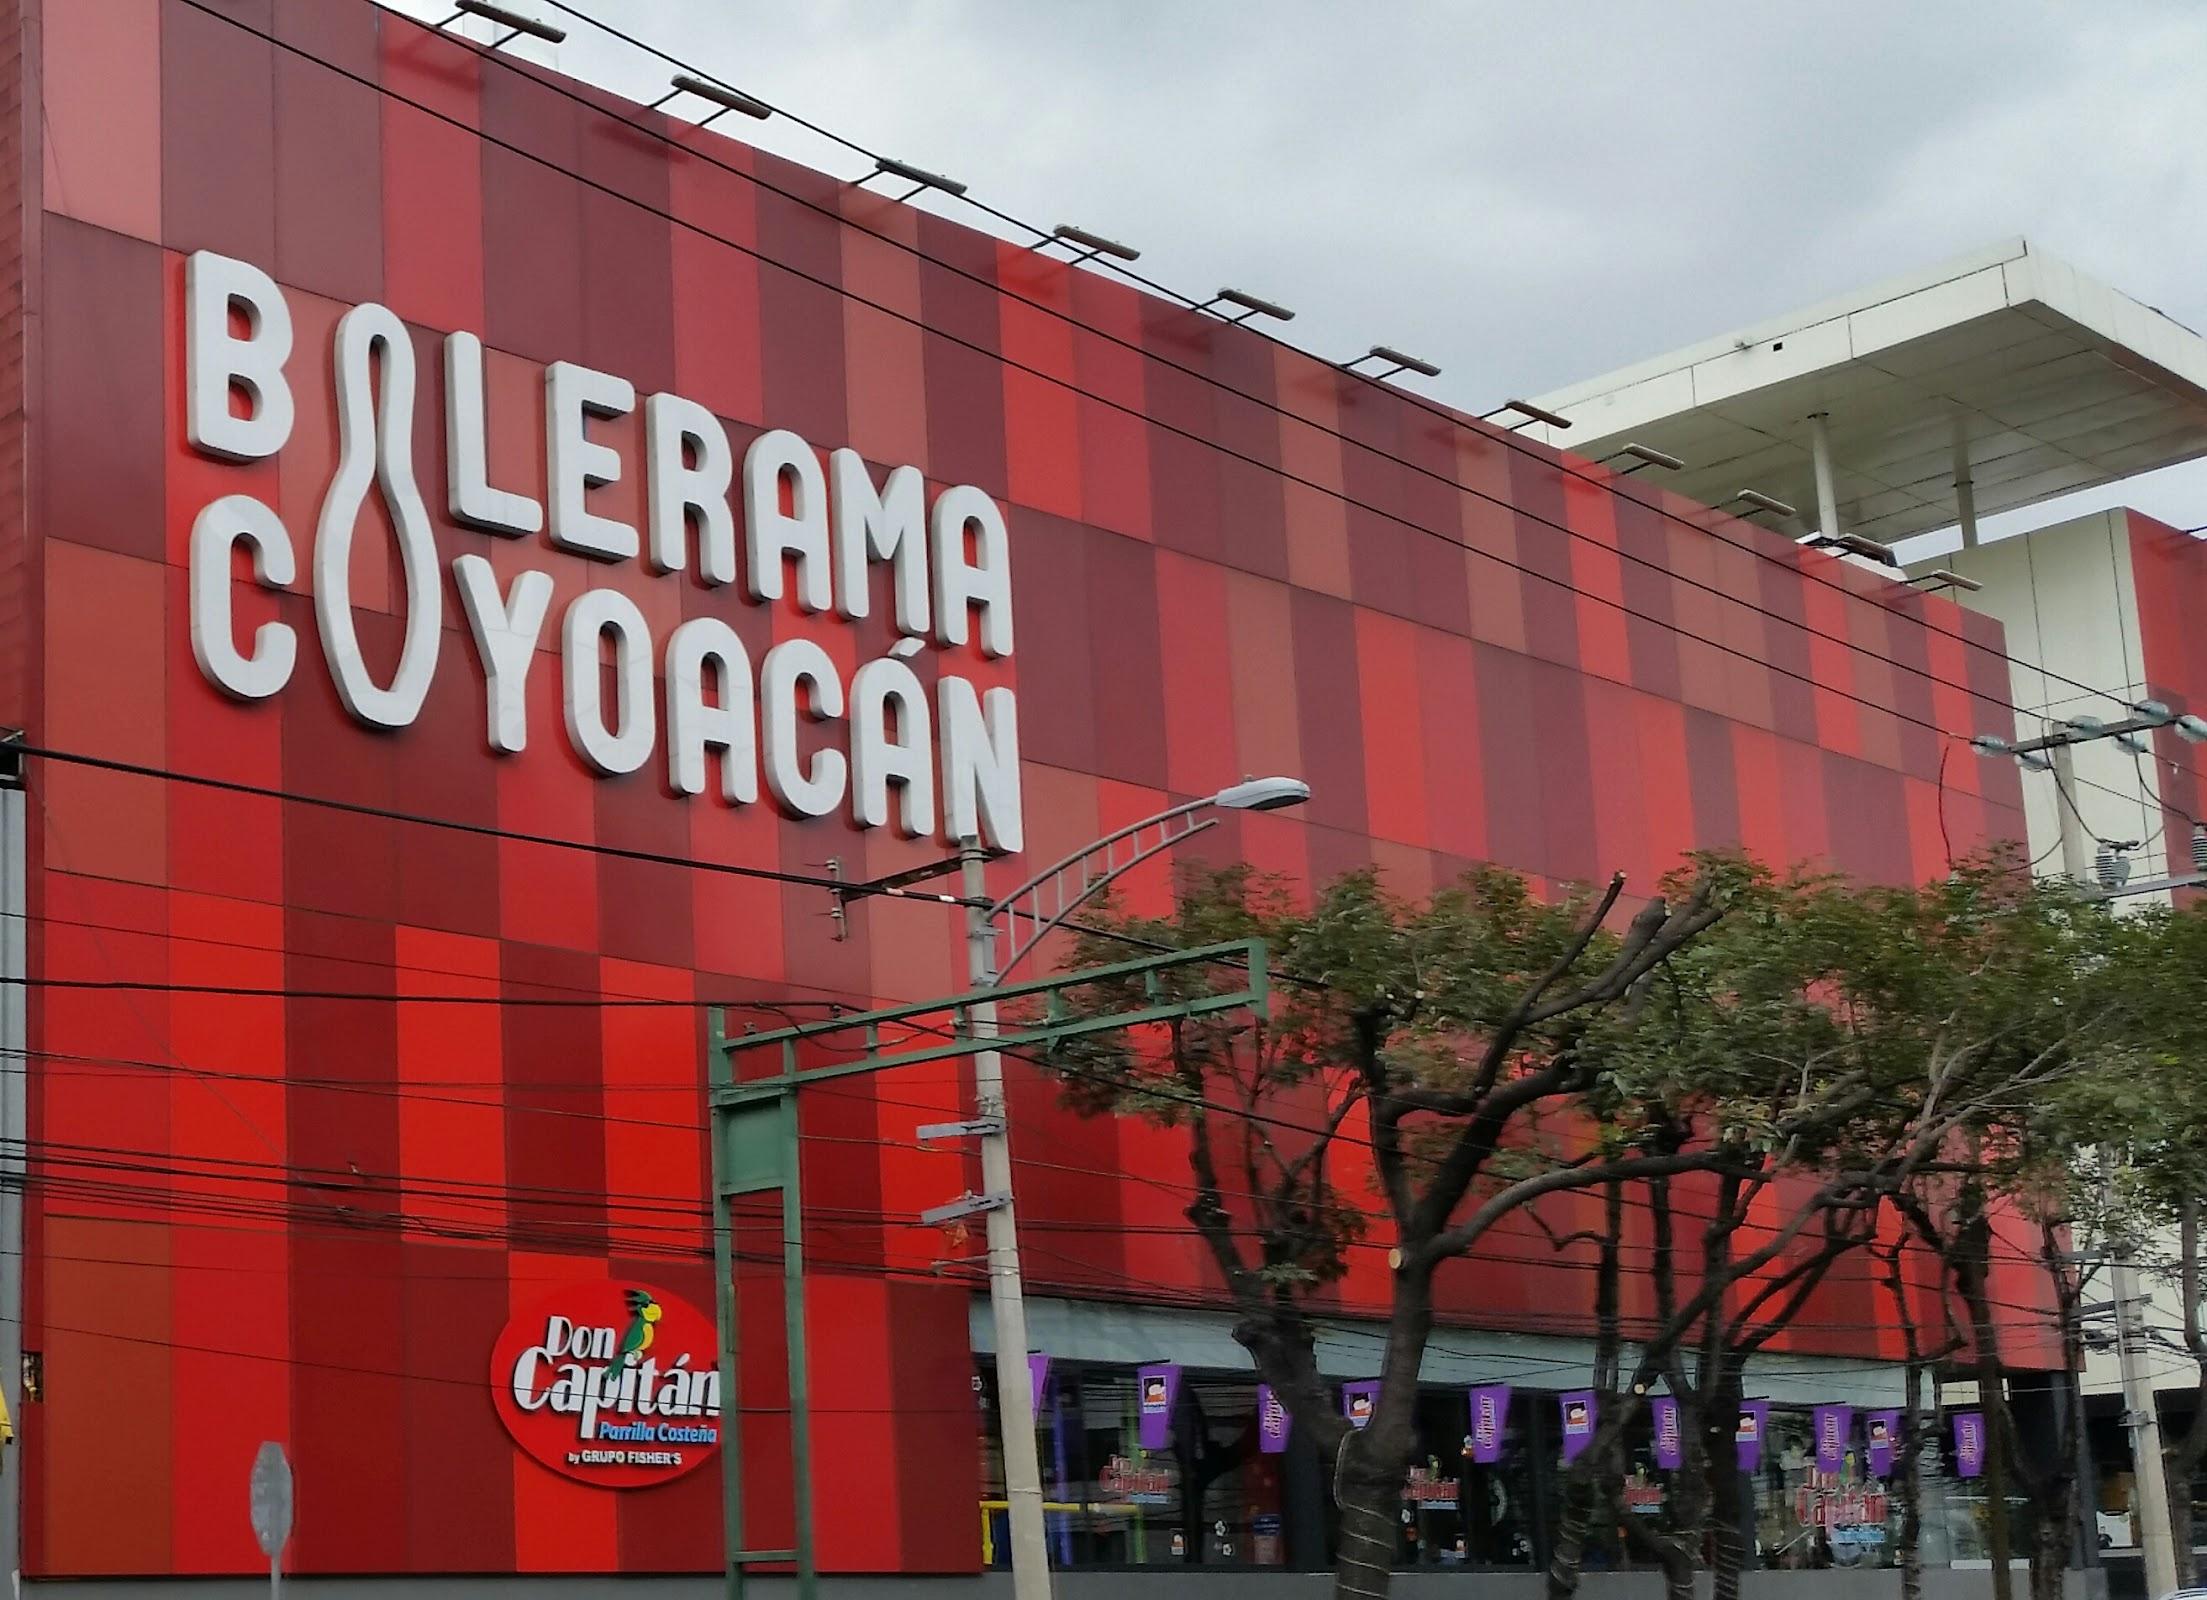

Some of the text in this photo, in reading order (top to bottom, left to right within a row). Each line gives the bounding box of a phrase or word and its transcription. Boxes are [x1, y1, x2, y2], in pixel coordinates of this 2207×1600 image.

[546, 1315, 616, 1359] Don
[513, 1345, 721, 1439] Capitán
[599, 1421, 717, 1442] Parrilla Costeña
[568, 1450, 682, 1465] by GRUPO FISHER'S
